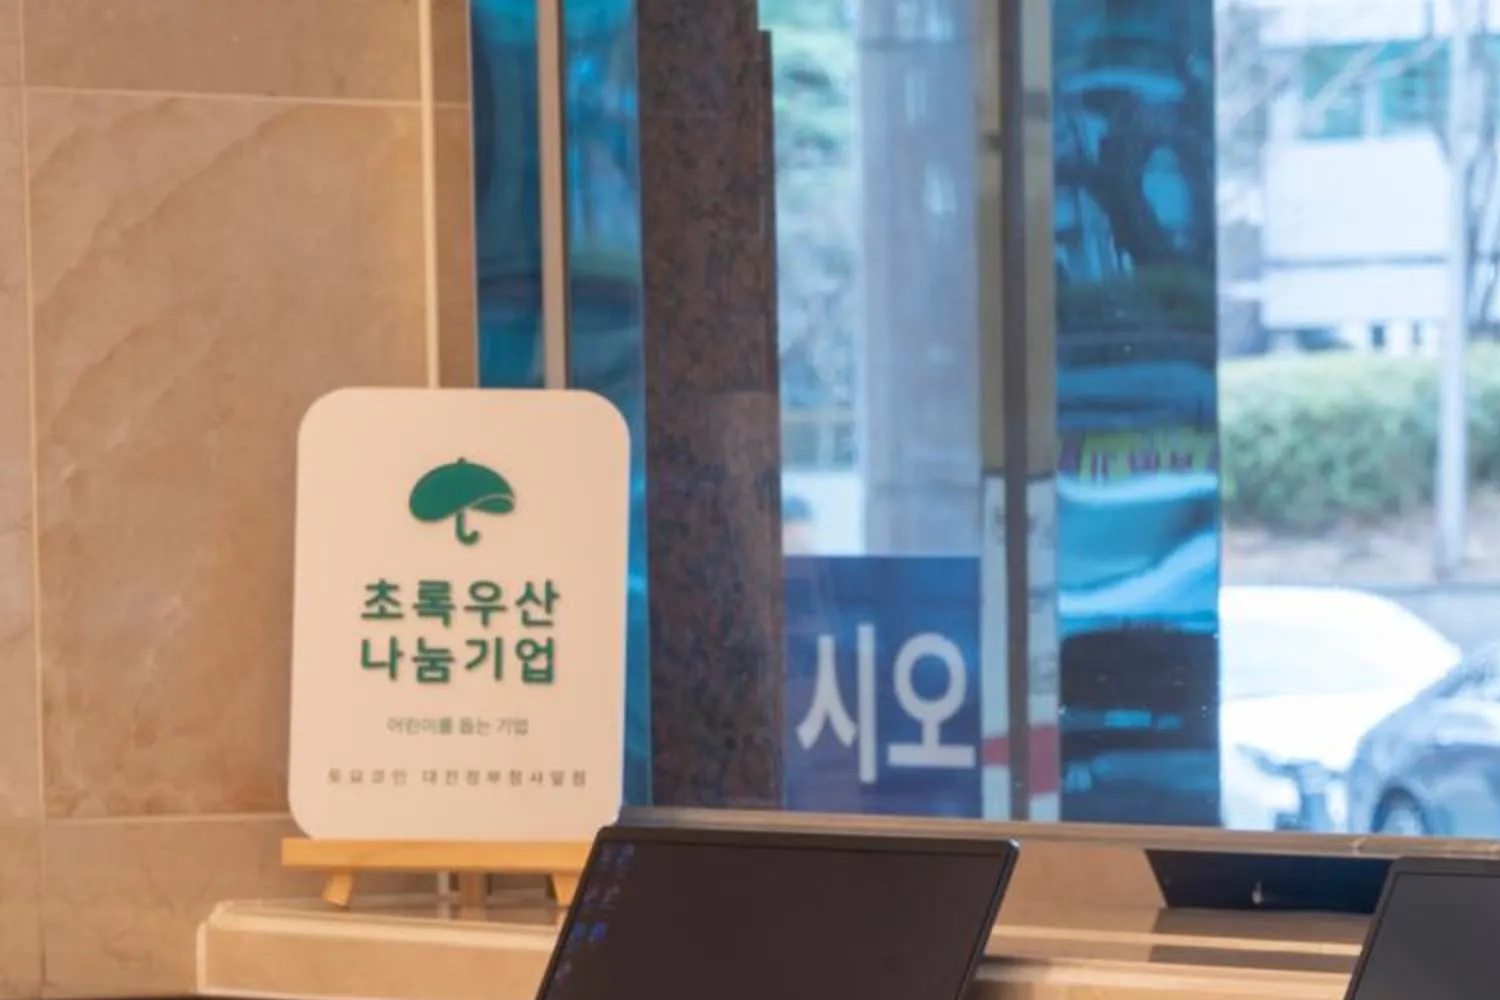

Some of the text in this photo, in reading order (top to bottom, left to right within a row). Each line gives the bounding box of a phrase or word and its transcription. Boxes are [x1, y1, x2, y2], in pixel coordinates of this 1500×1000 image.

[360, 579, 560, 627] 초록우산
[360, 636, 556, 685] 나눔기업
[386, 717, 453, 734] 어린이를
[497, 718, 529, 736] 기업
[796, 623, 975, 784] 시오
